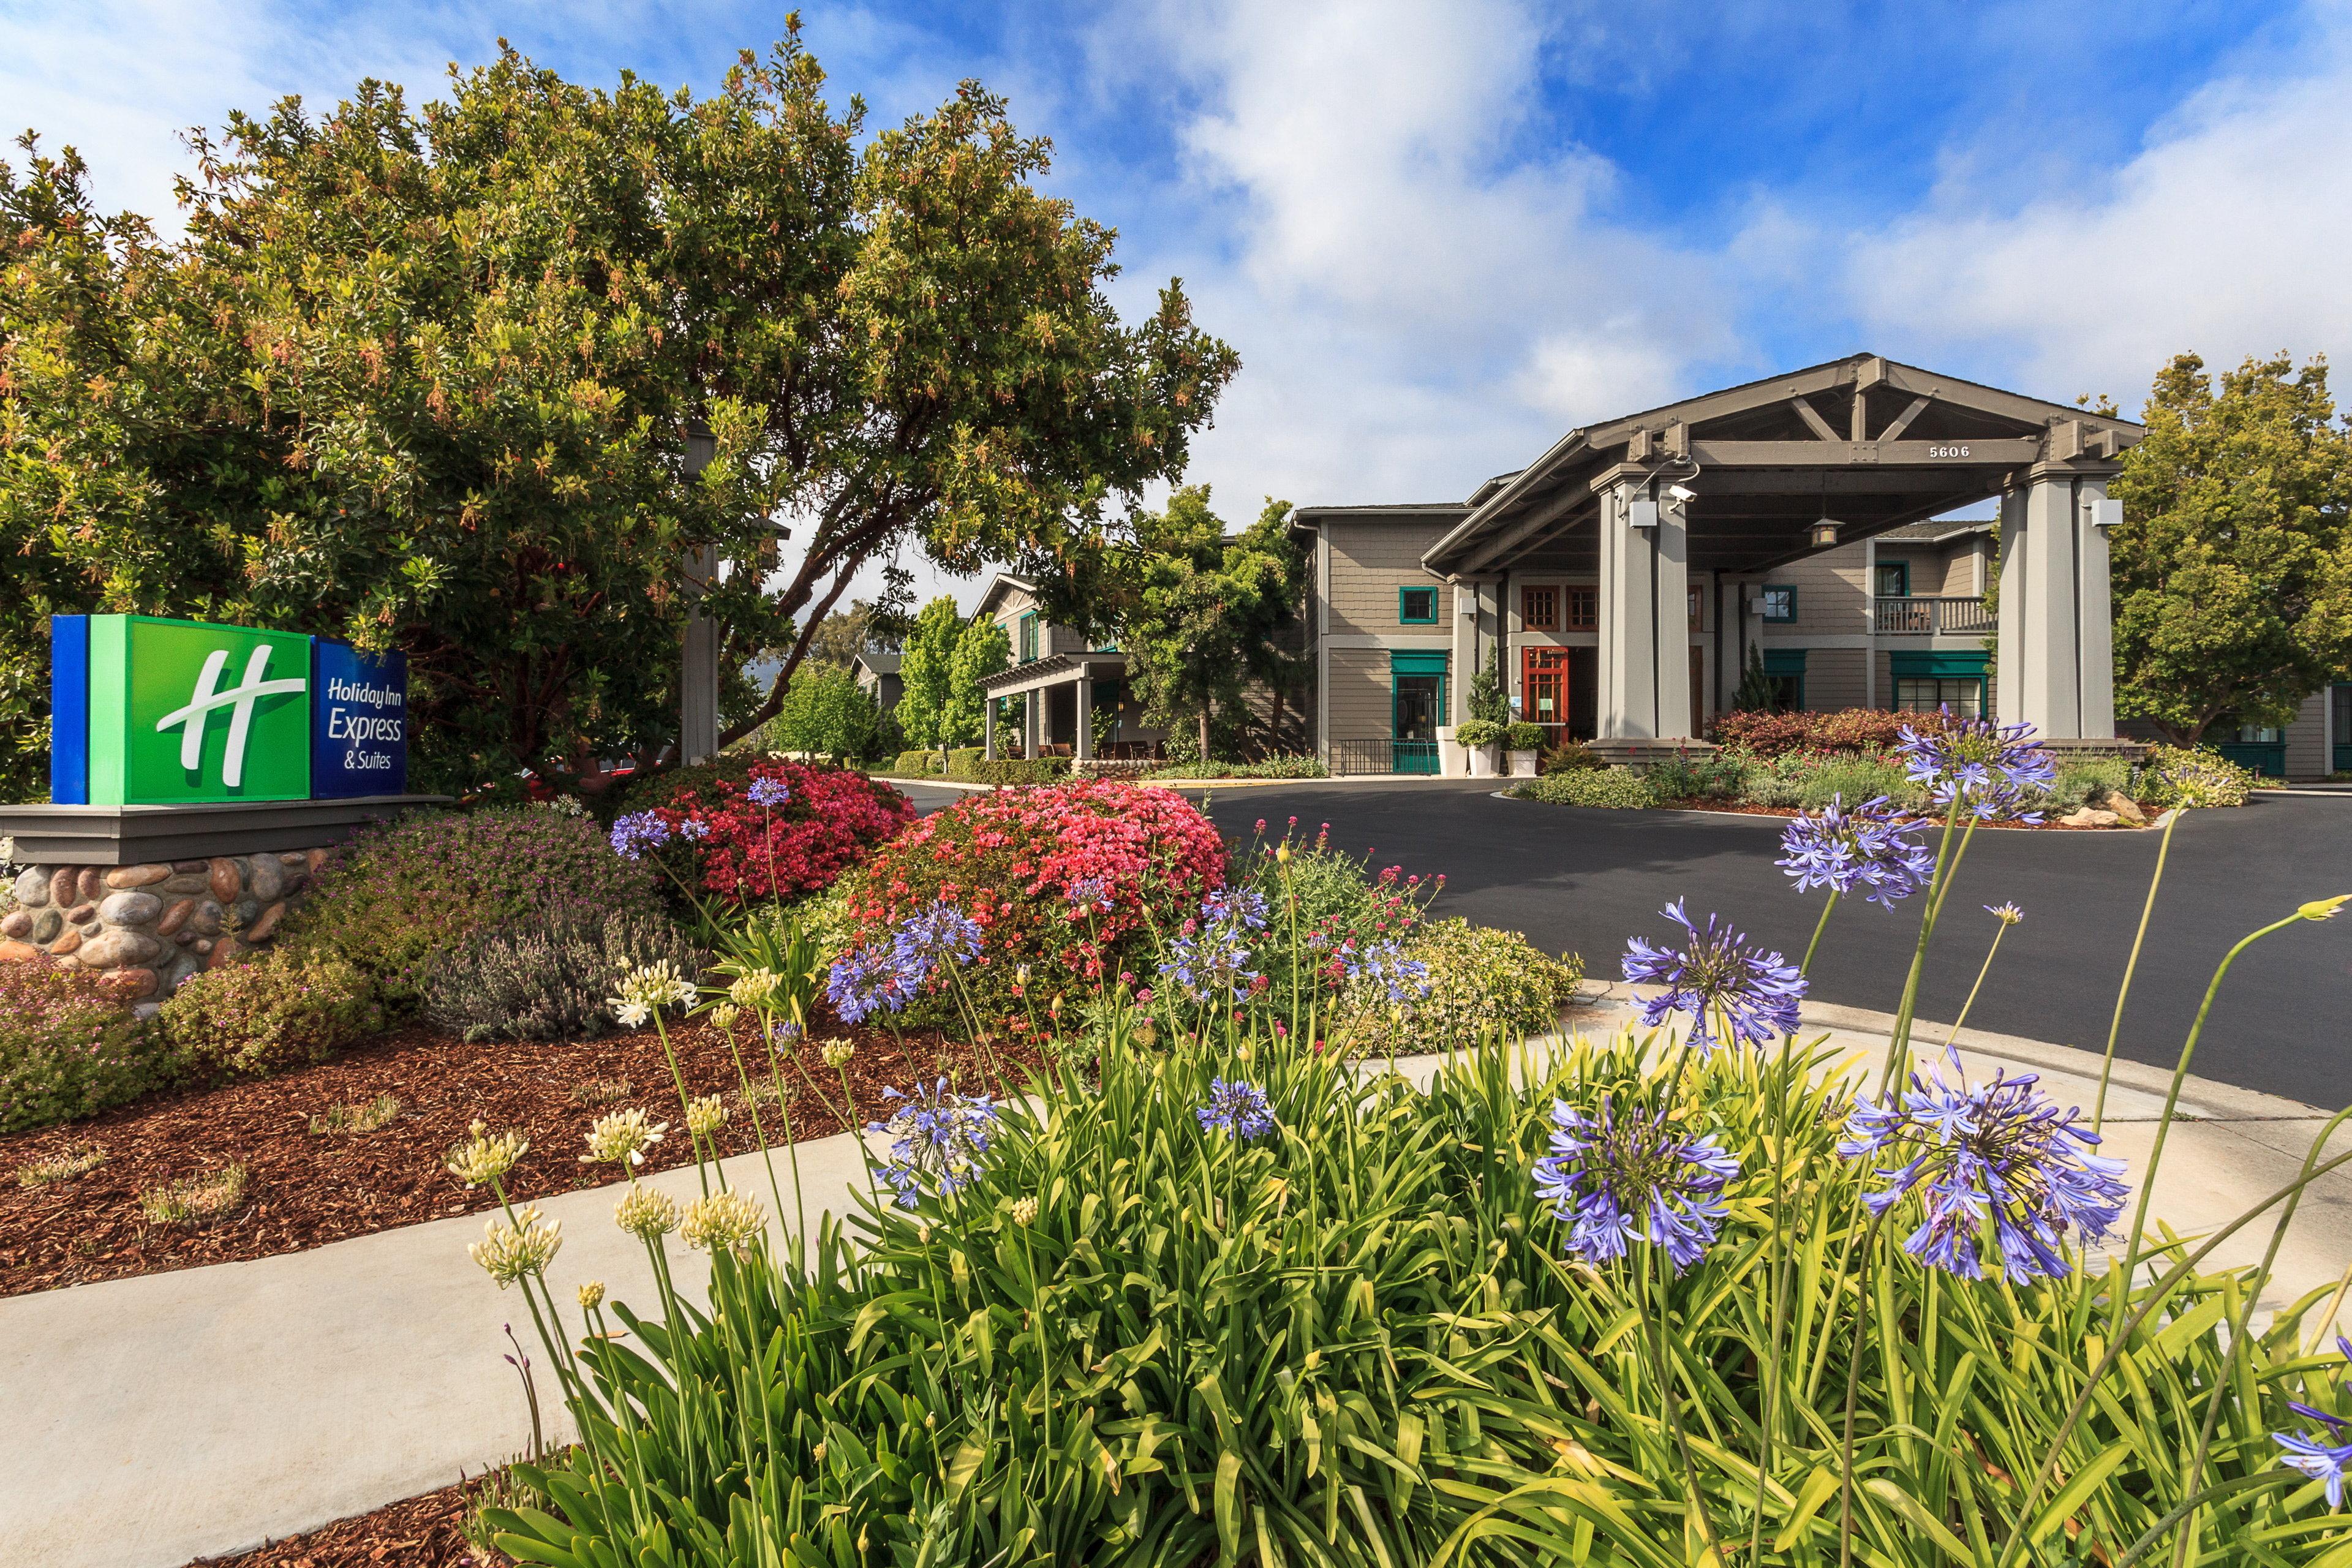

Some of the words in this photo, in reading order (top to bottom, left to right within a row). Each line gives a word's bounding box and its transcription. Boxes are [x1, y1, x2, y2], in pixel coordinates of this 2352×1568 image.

[1929, 446, 1970, 458] 5606
[328, 677, 384, 709] Holiday
[385, 685, 402, 706] Inn
[156, 644, 306, 787] H
[328, 707, 401, 748] Express
[344, 750, 355, 769] &
[357, 750, 391, 769] Suites
